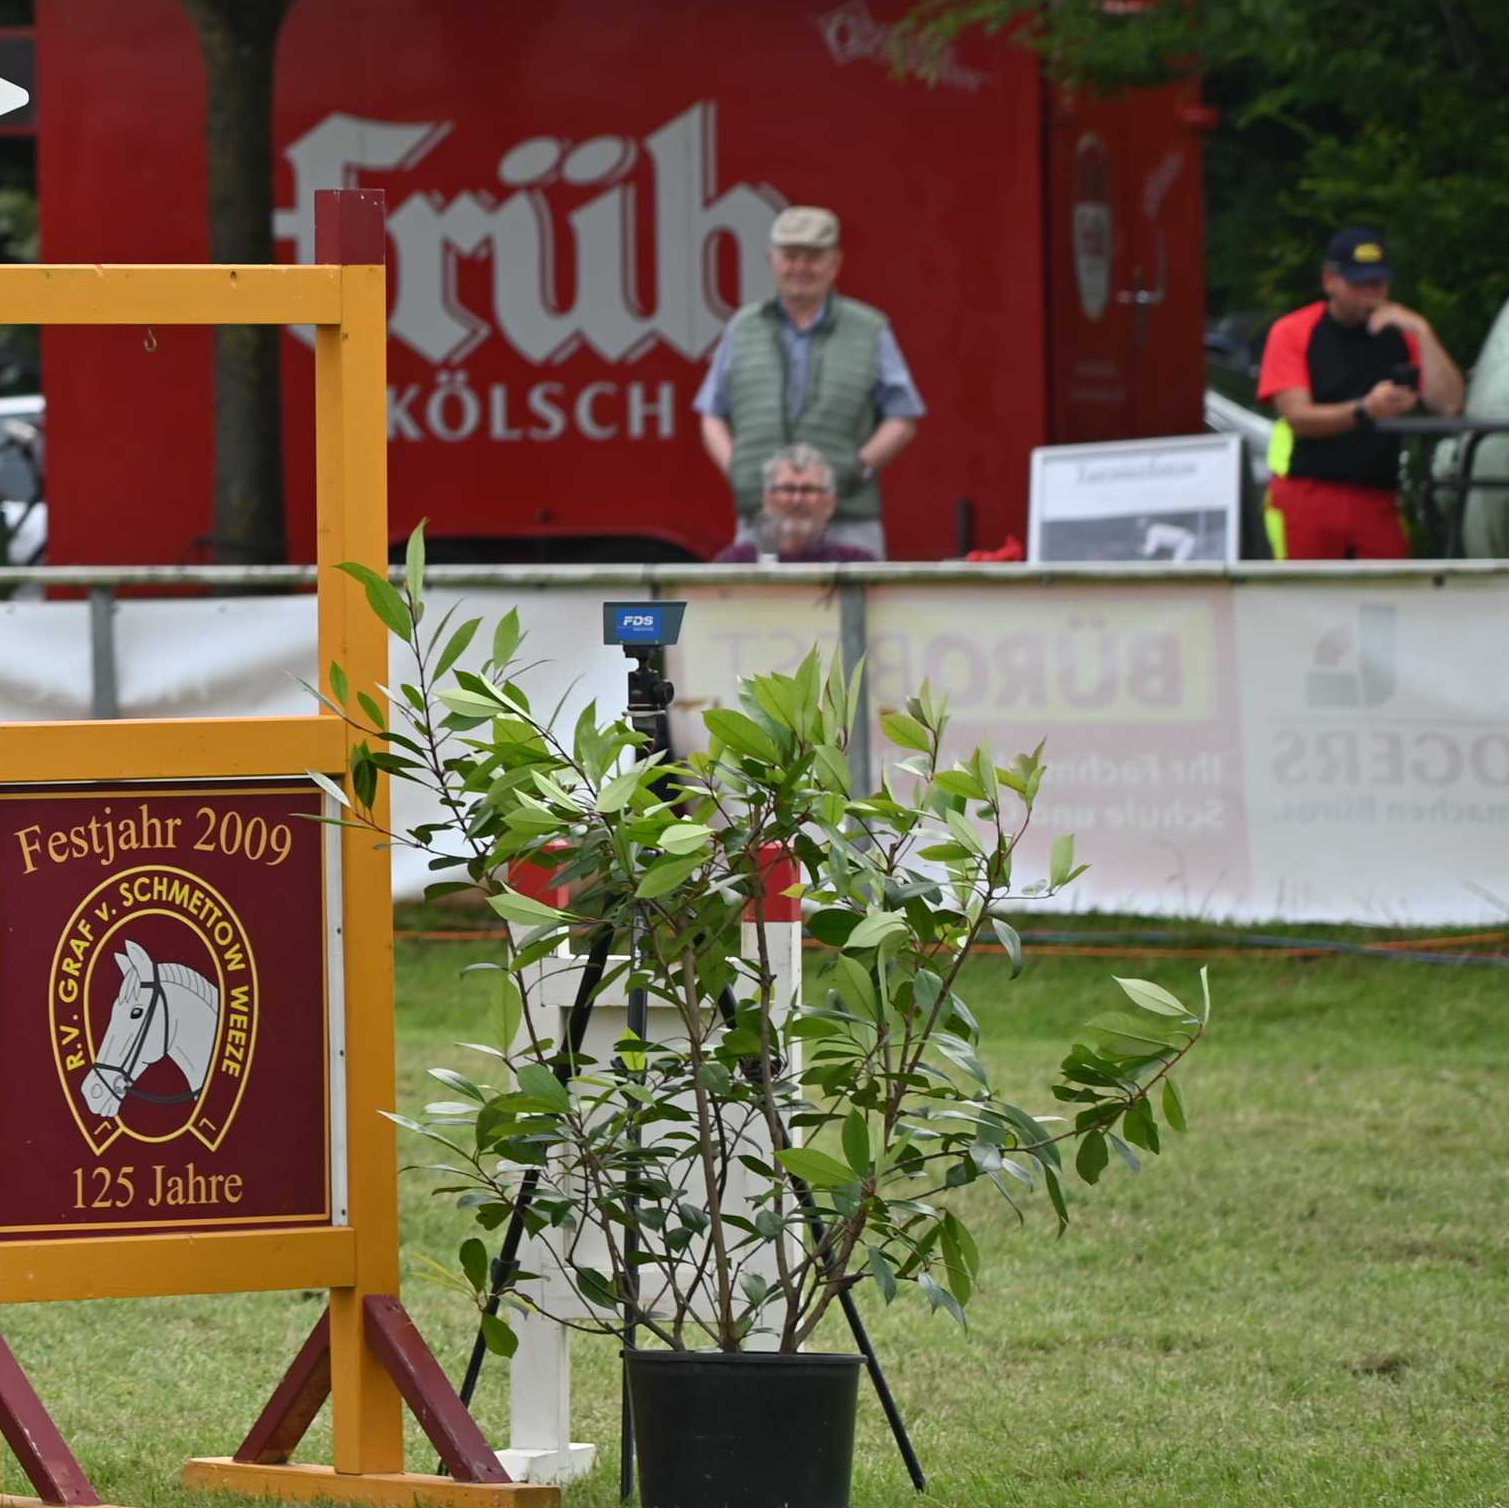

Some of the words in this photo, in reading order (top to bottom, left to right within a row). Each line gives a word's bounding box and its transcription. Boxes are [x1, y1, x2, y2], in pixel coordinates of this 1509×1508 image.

[622, 615, 654, 627] FDS
[14, 804, 181, 874] Festjahr
[193, 807, 293, 866] 2009
[95, 902, 117, 922] v.
[119, 876, 245, 972] SCHMETTOW
[58, 919, 95, 1003] GRAF
[60, 1014, 86, 1071] R.V.
[221, 985, 250, 1078] WEEZE
[72, 1166, 134, 1209] 125
[148, 1163, 243, 1207] Jahre
